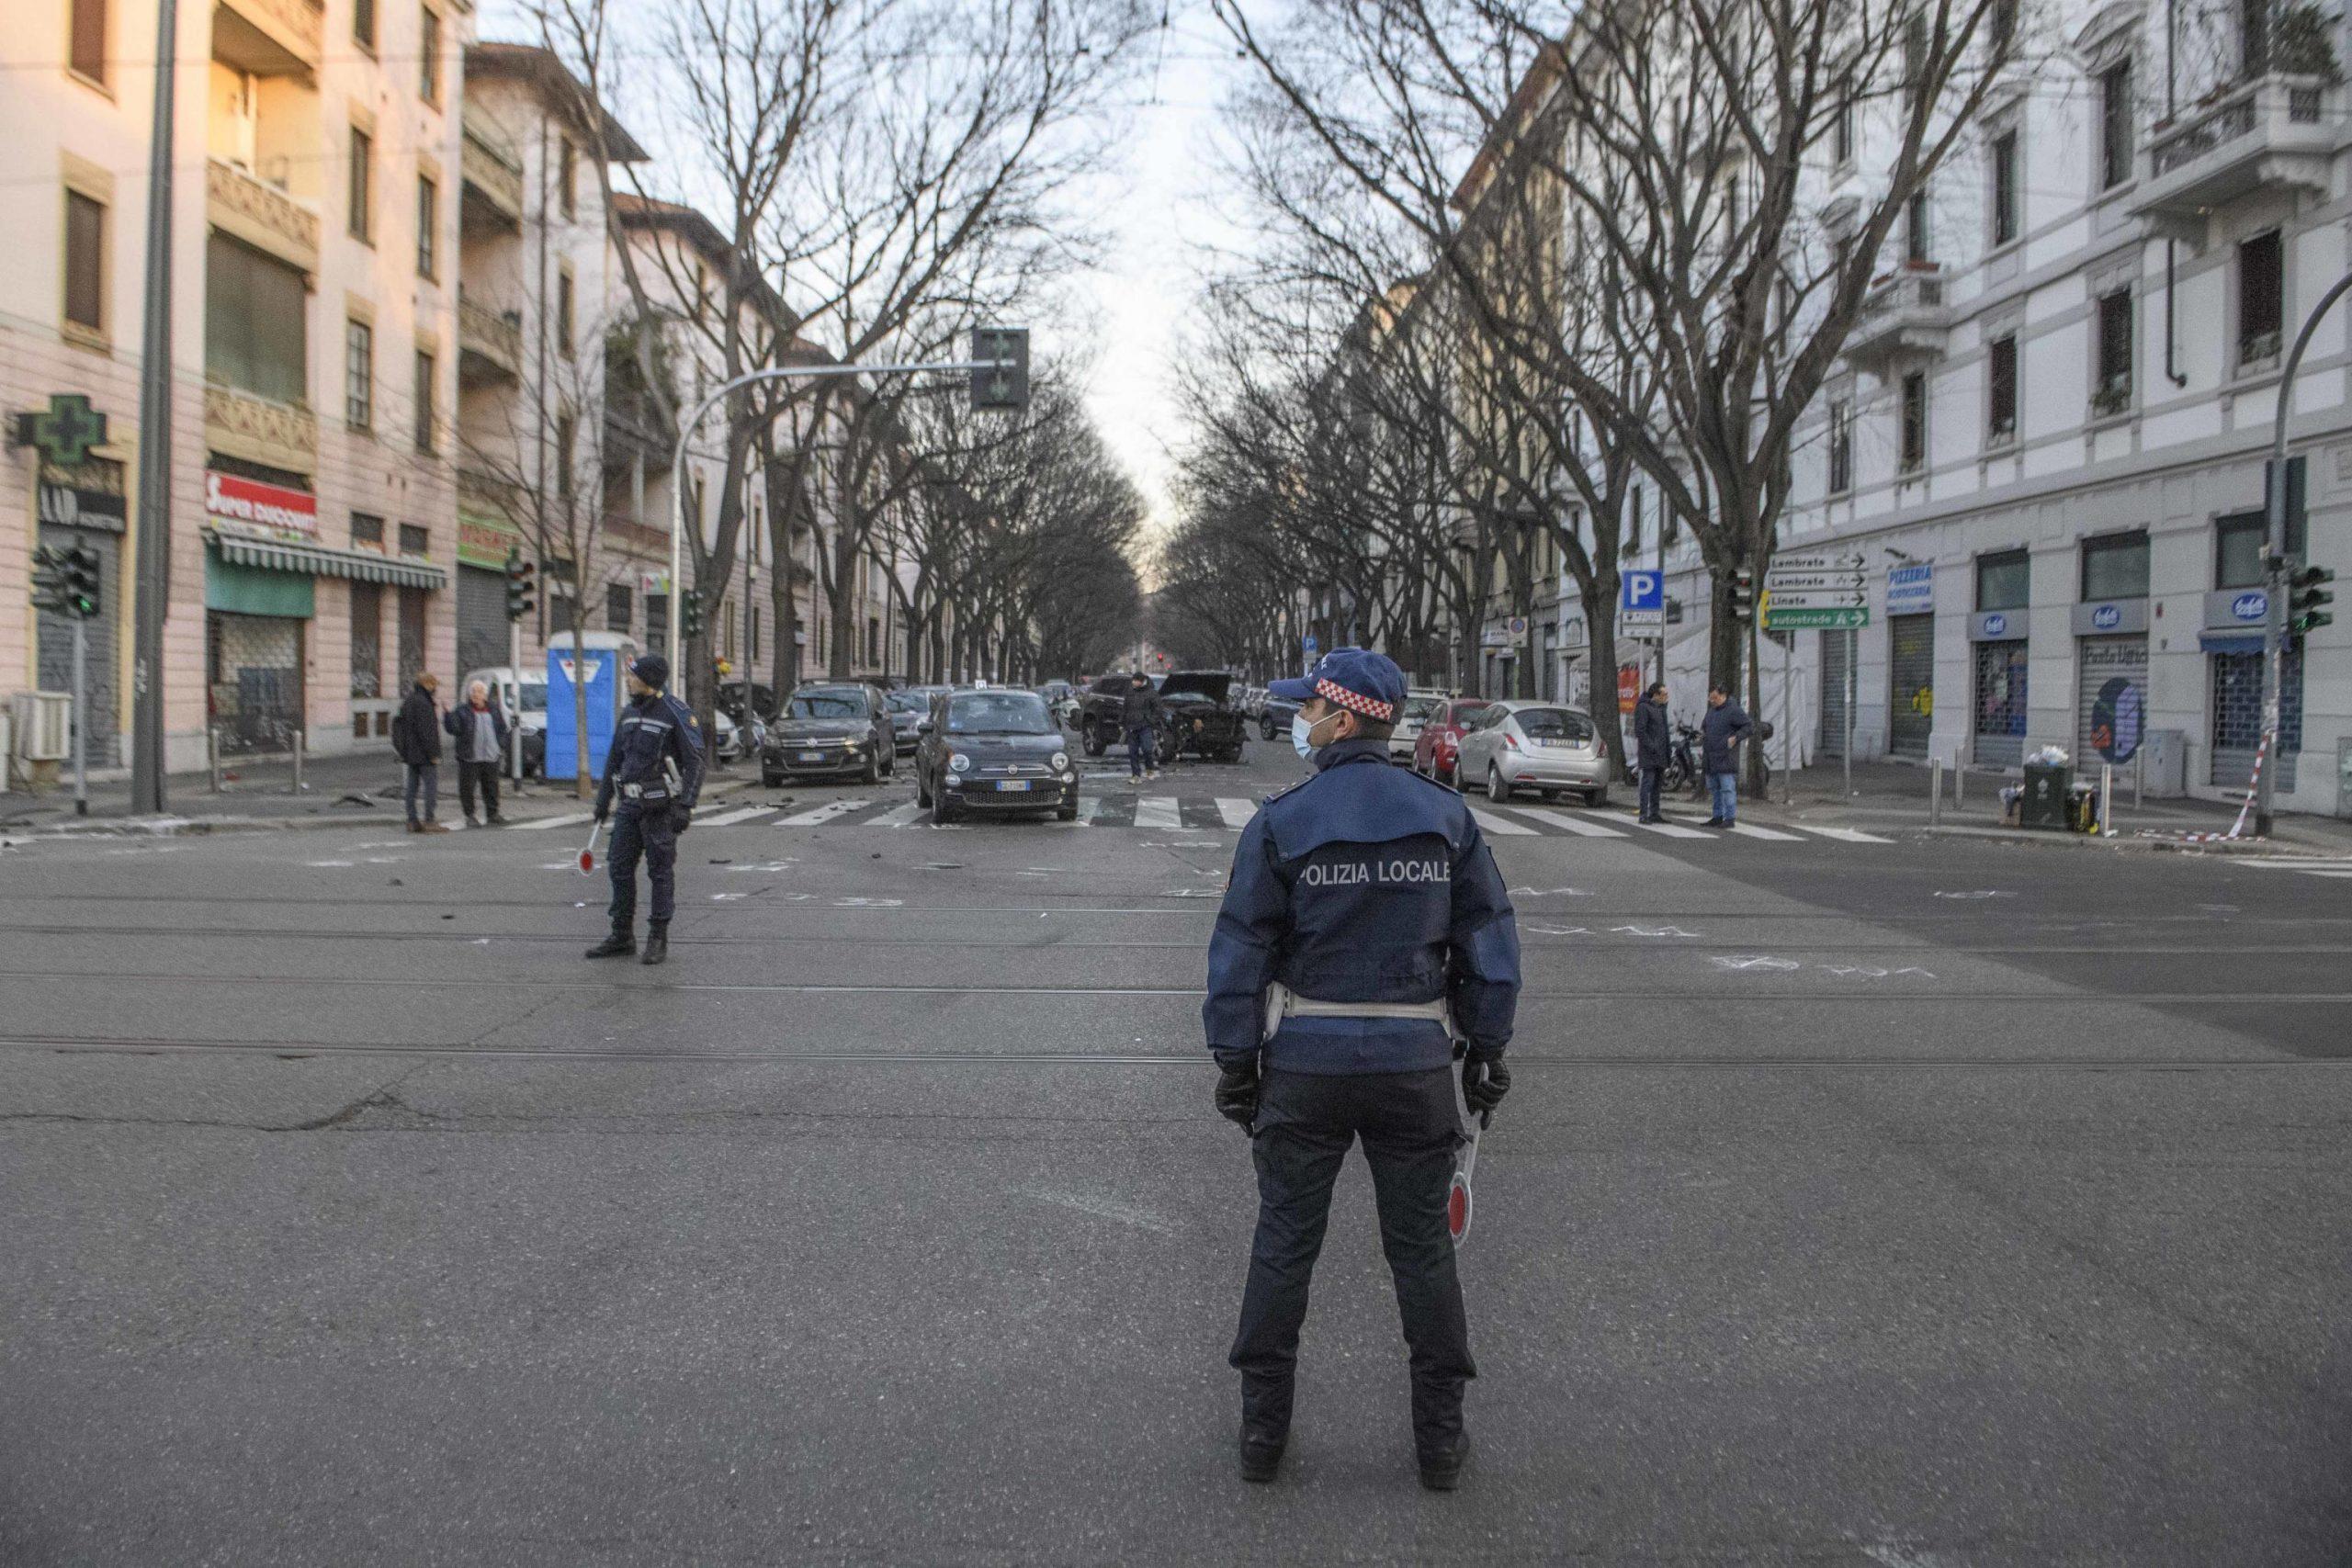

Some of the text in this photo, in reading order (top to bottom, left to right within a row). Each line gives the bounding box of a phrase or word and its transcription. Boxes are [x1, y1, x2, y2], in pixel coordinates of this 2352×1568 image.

[1771, 557, 1825, 569] Lambrate
[1888, 564, 1931, 585] PIZZERIA
[1771, 576, 1825, 587] Lambrate
[1631, 574, 1654, 605] P
[1771, 596, 1806, 606] Linate
[1771, 614, 1832, 626] autostrade
[1378, 861, 1451, 882] LOCALE
